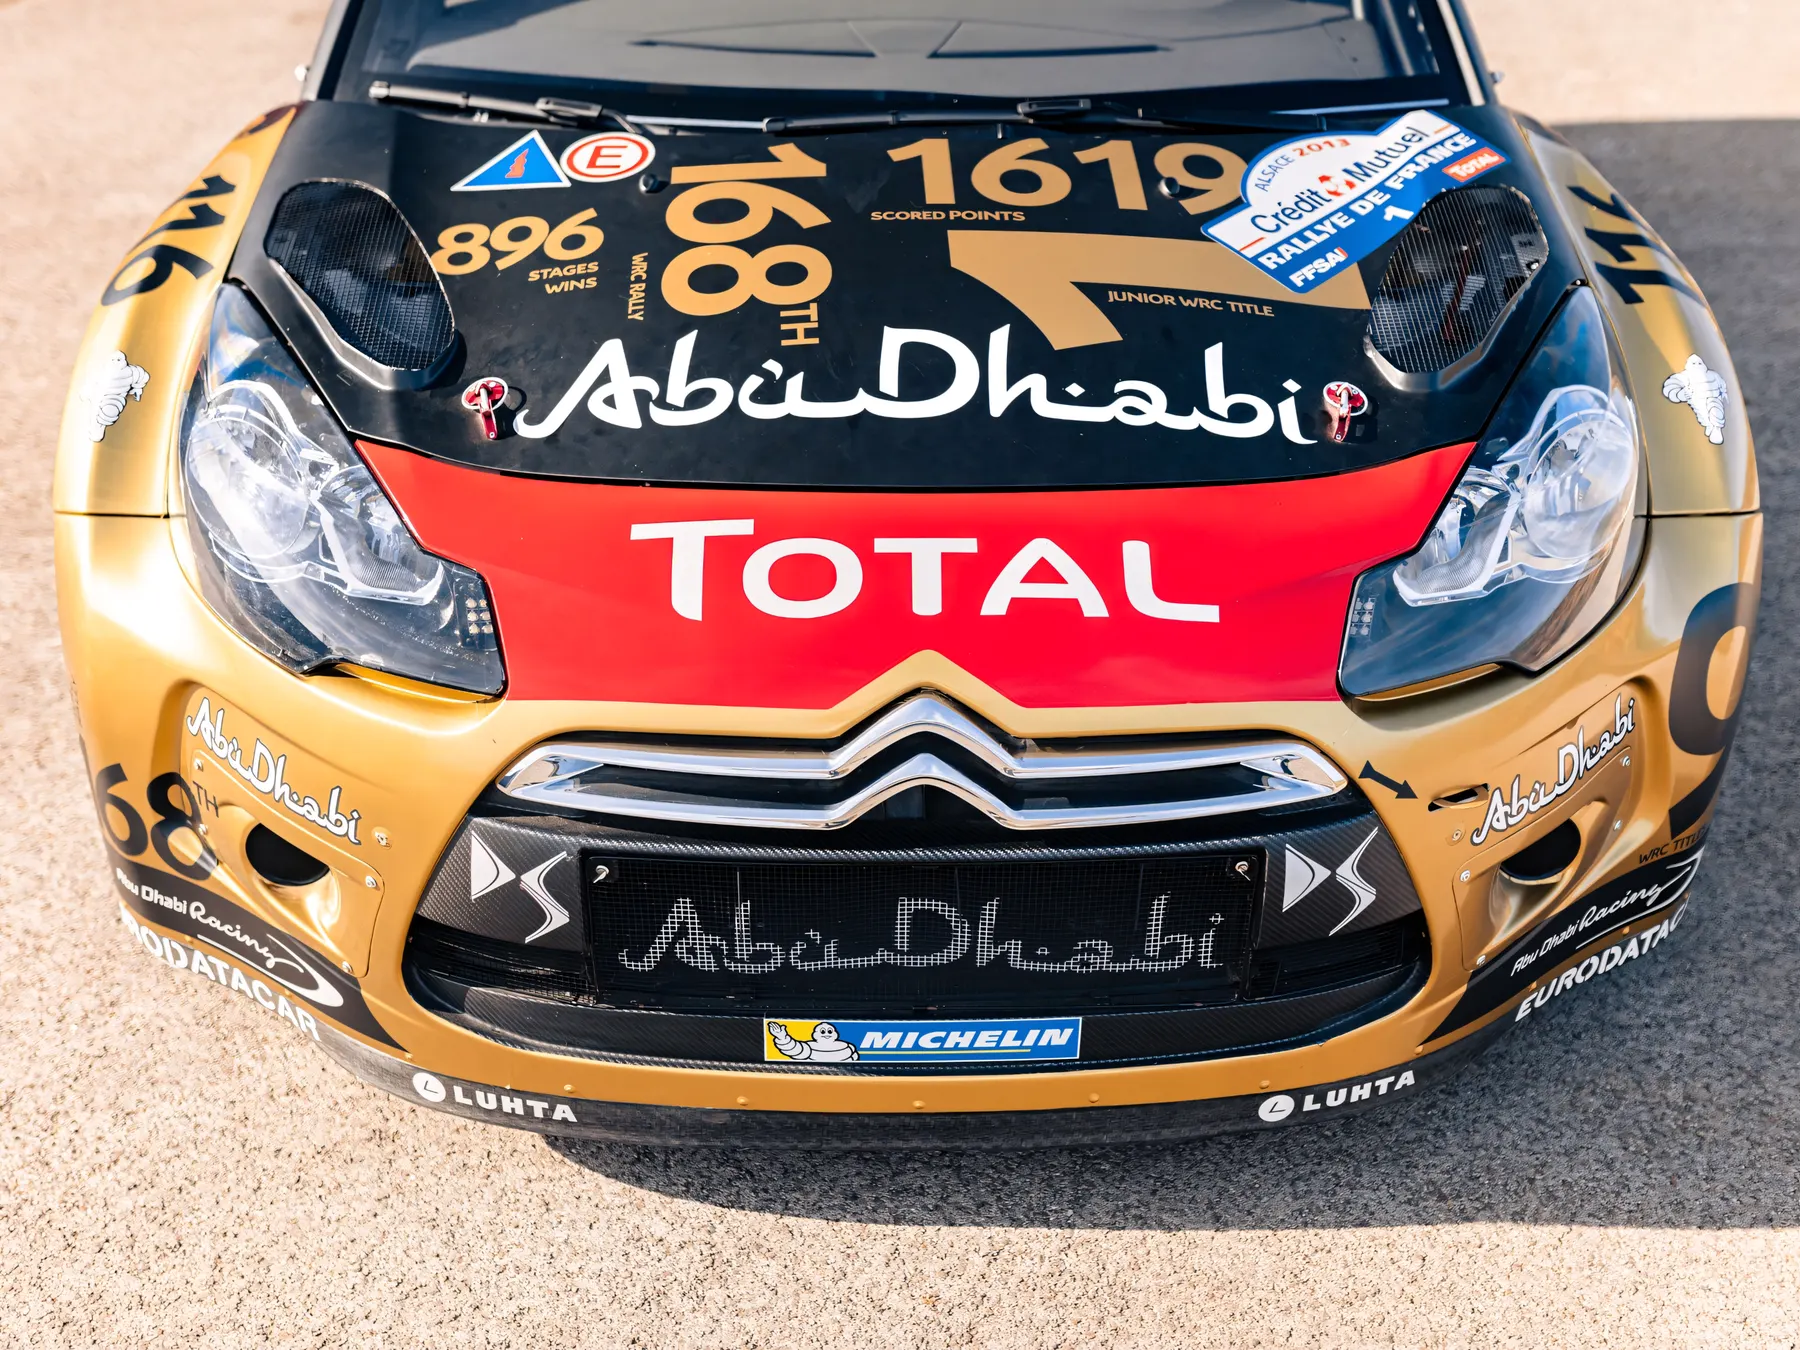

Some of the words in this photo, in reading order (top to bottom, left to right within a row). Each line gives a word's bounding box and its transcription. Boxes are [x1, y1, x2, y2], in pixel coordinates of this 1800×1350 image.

[585, 144, 629, 169] E
[886, 136, 1249, 215] 1619
[1254, 154, 1295, 192] ALSACE
[1292, 138, 1351, 157] 2013
[1447, 150, 1501, 179] TOTAL
[1250, 187, 1331, 234] Crédit
[1341, 125, 1430, 185] Mutuel
[1257, 210, 1356, 271] RALLYE
[1350, 188, 1392, 217] DE
[1384, 132, 1478, 192] FRANCE
[660, 142, 833, 317] 168
[870, 210, 945, 222] SCORED
[948, 210, 1026, 223] POINTS
[1382, 203, 1415, 222] 1
[430, 207, 605, 276] 896
[528, 261, 599, 282] STAGES
[544, 277, 598, 294] WINS
[631, 252, 649, 282] WRC
[627, 281, 647, 321] RALLY
[1107, 289, 1176, 307] JUNIOR
[1178, 295, 1223, 312] WRC
[1225, 301, 1275, 318] TITLE
[779, 302, 820, 347] TH
[857, 322, 1318, 445] Dhabi
[630, 518, 1220, 623] TOTAL
[1554, 692, 1636, 790] Dhabi
[193, 780, 219, 819] TH
[249, 738, 362, 846] Dhabi
[1638, 844, 1669, 865] WRC
[141, 884, 188, 915] Dhabi
[188, 901, 280, 969] Racing
[881, 891, 1224, 973] Dhabi
[1510, 950, 1540, 977] Abu
[1539, 919, 1580, 957] Dhabi
[1577, 883, 1664, 933] Racing
[859, 1025, 1075, 1050] MICHELIN
[453, 1085, 578, 1123] LUHTA
[1302, 1069, 1416, 1112] LUHTA
